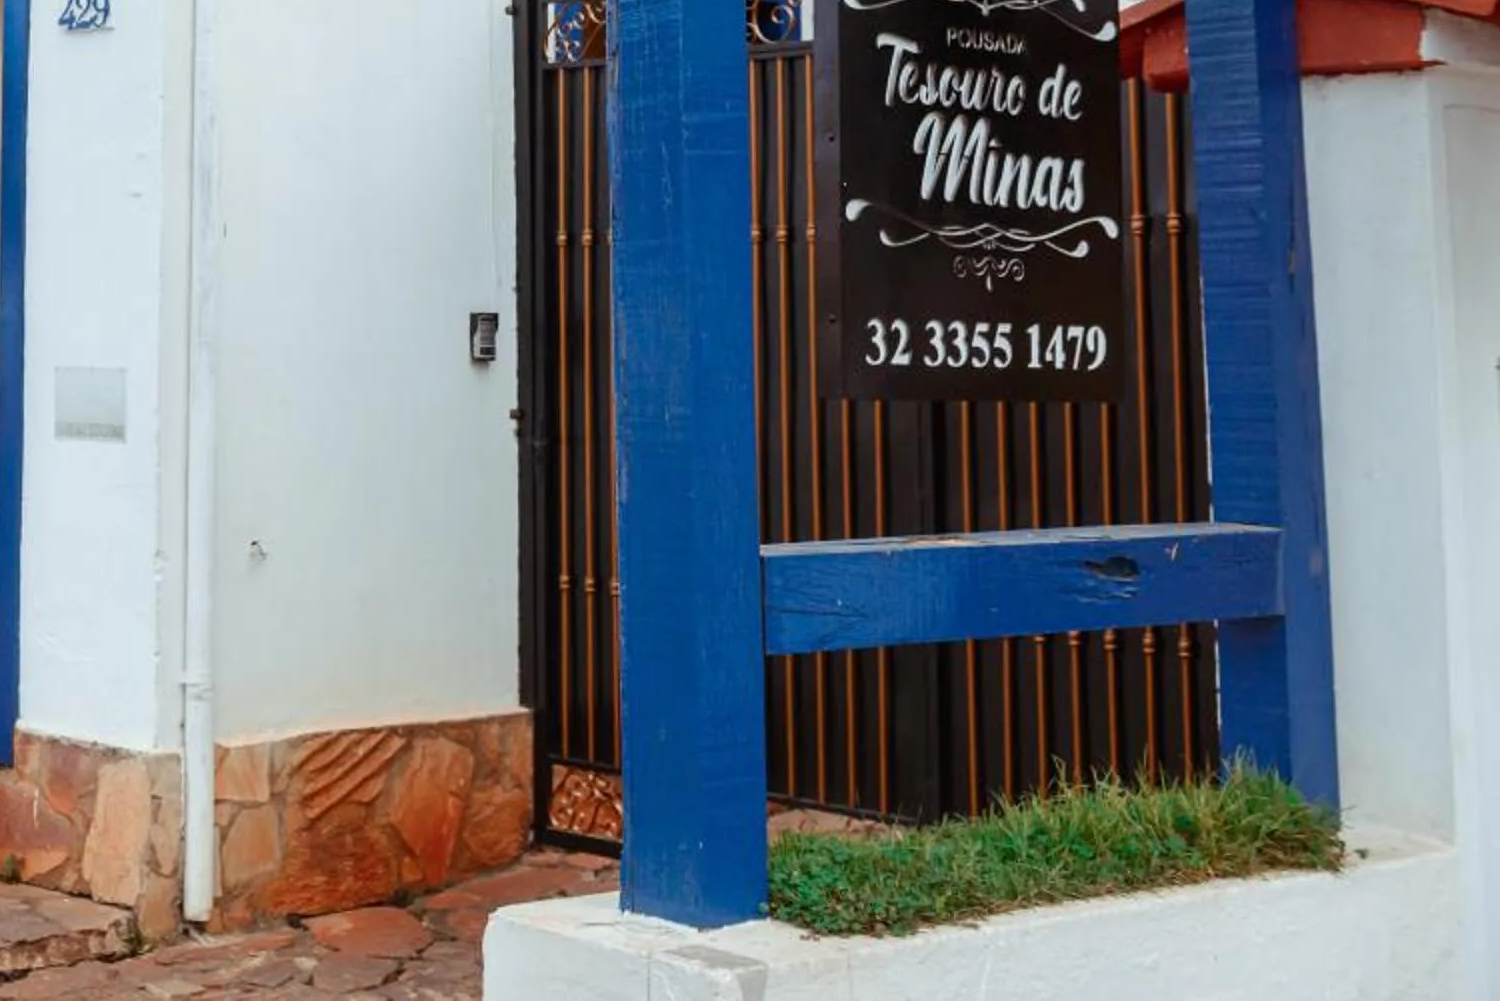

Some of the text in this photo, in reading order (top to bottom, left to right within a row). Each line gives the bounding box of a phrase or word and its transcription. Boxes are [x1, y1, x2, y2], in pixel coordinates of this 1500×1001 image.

[876, 33, 1084, 121] Tesouro de
[913, 111, 1085, 213] Minas
[865, 317, 1107, 371] 32 3355 1479
